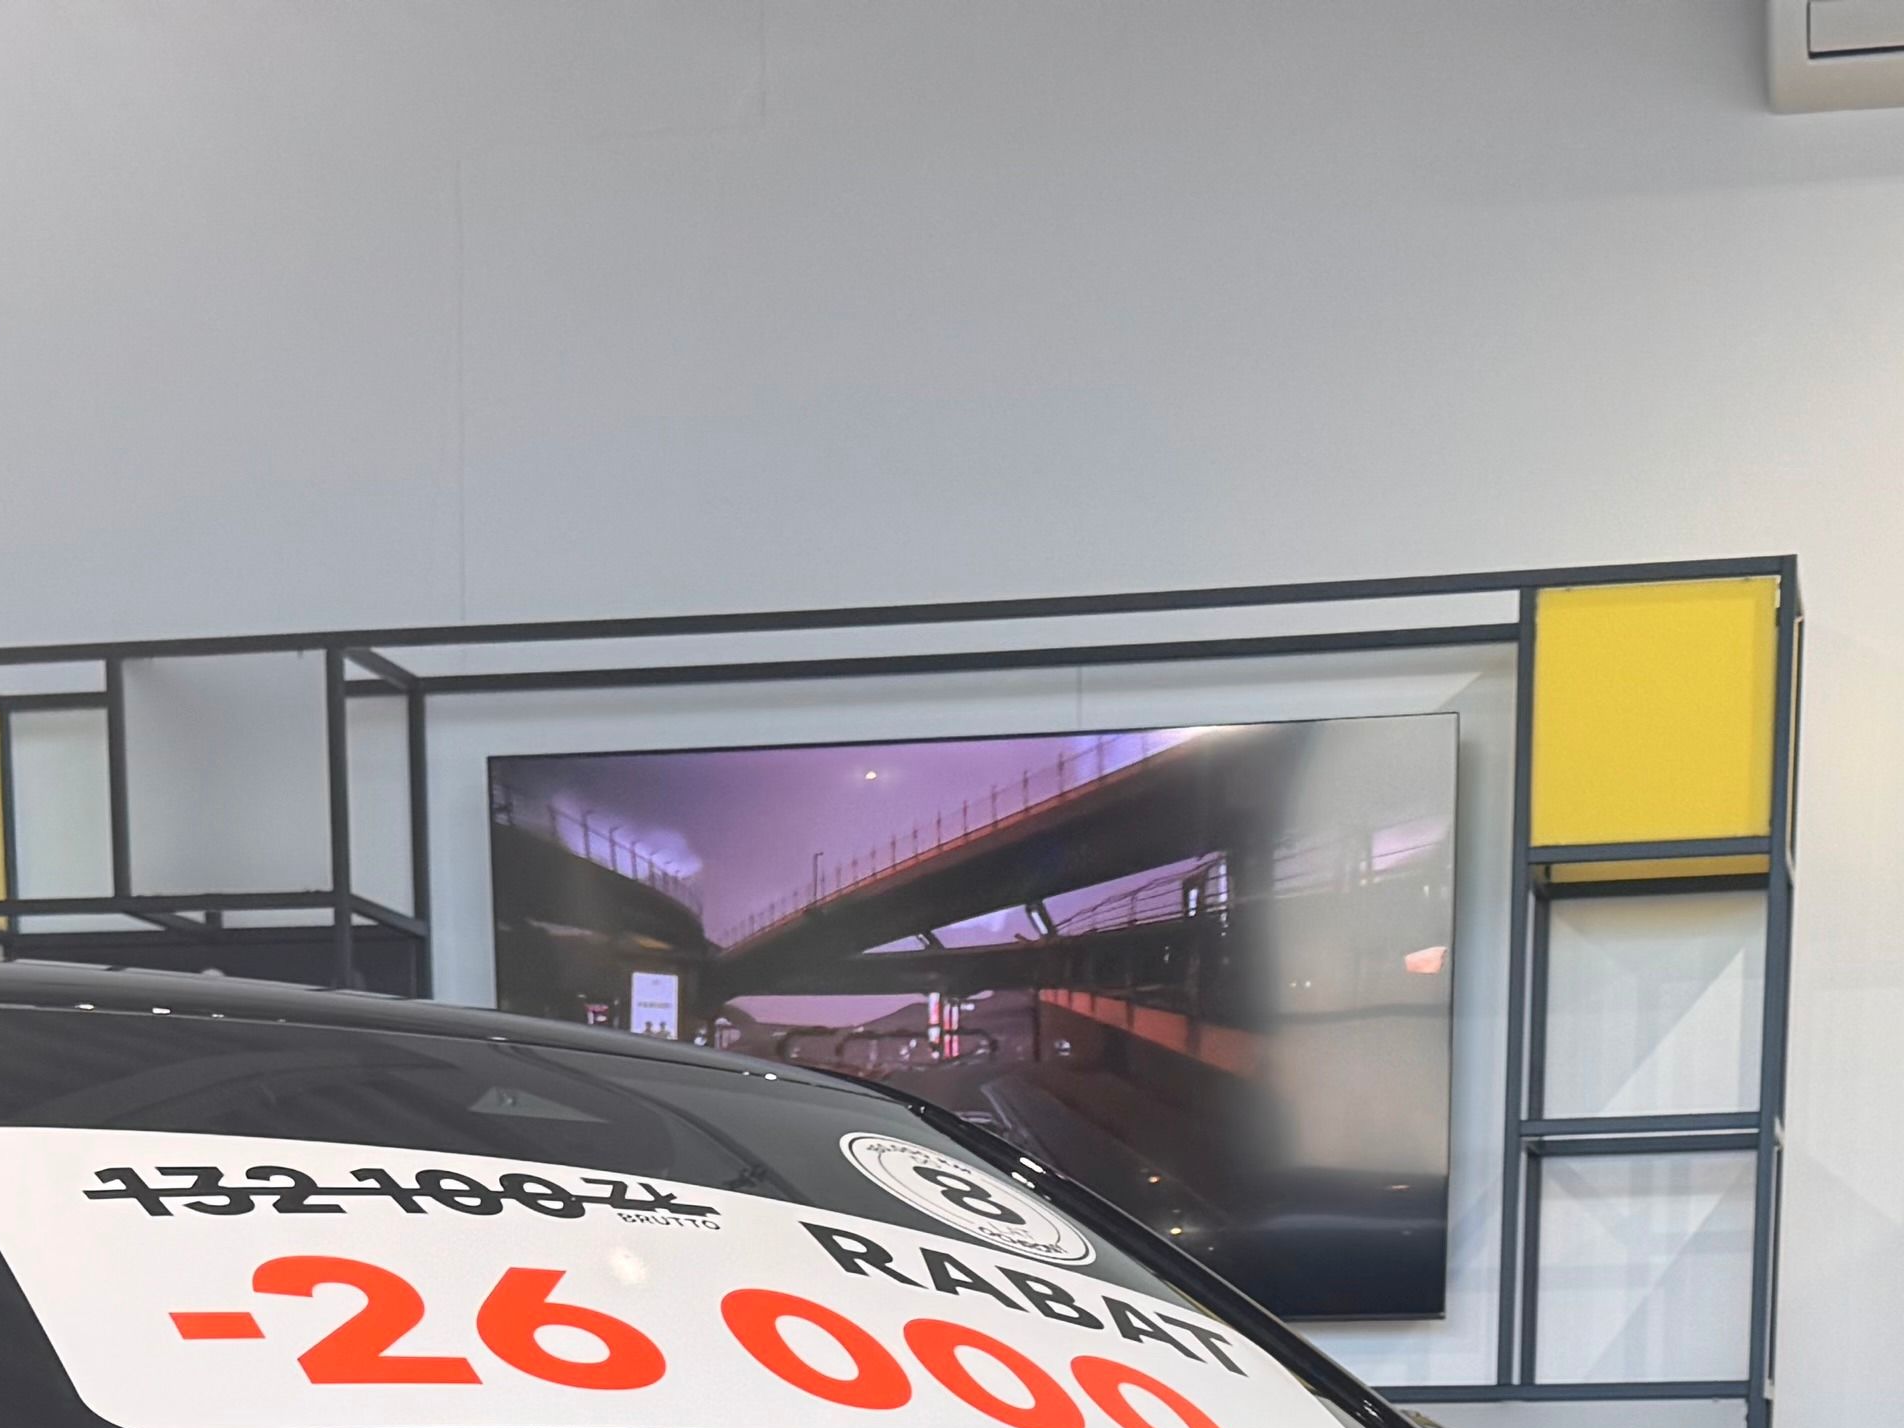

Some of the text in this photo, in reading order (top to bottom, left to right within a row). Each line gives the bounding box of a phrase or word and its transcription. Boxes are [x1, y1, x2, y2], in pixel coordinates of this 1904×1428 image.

[92, 1165, 347, 1217] 132
[616, 1211, 722, 1231] BRUTTO
[912, 1165, 1027, 1225] 8
[169, 1256, 667, 1390] -26
[798, 1220, 1249, 1378] RABAT
